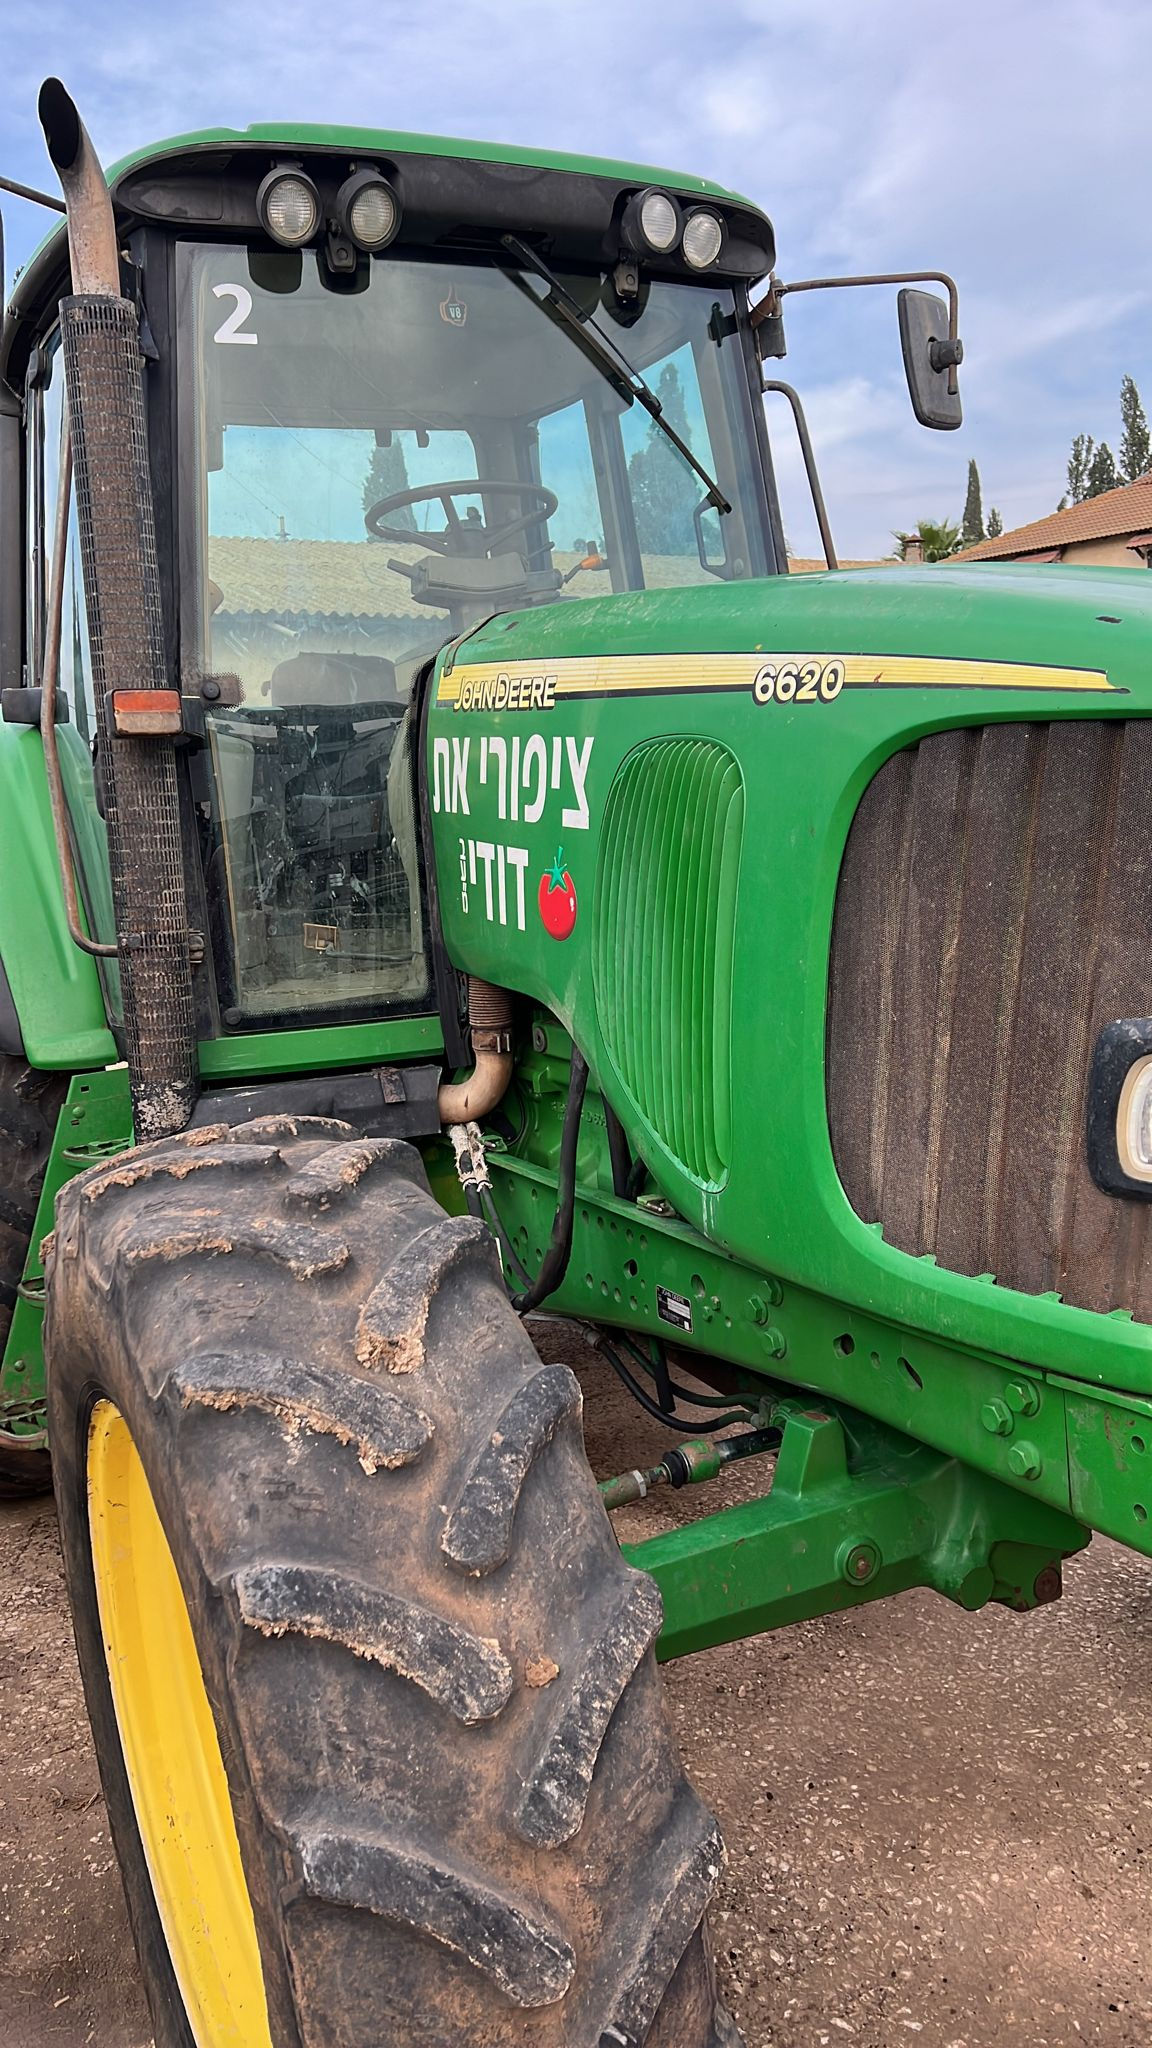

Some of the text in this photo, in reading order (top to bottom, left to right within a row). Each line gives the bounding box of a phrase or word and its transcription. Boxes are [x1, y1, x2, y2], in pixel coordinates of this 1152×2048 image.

[212, 283, 258, 345] 2
[453, 673, 558, 711] JOHN DEERE
[753, 659, 846, 706] 6620
[433, 733, 595, 830] ציפורי את
[468, 839, 529, 932] דודי
